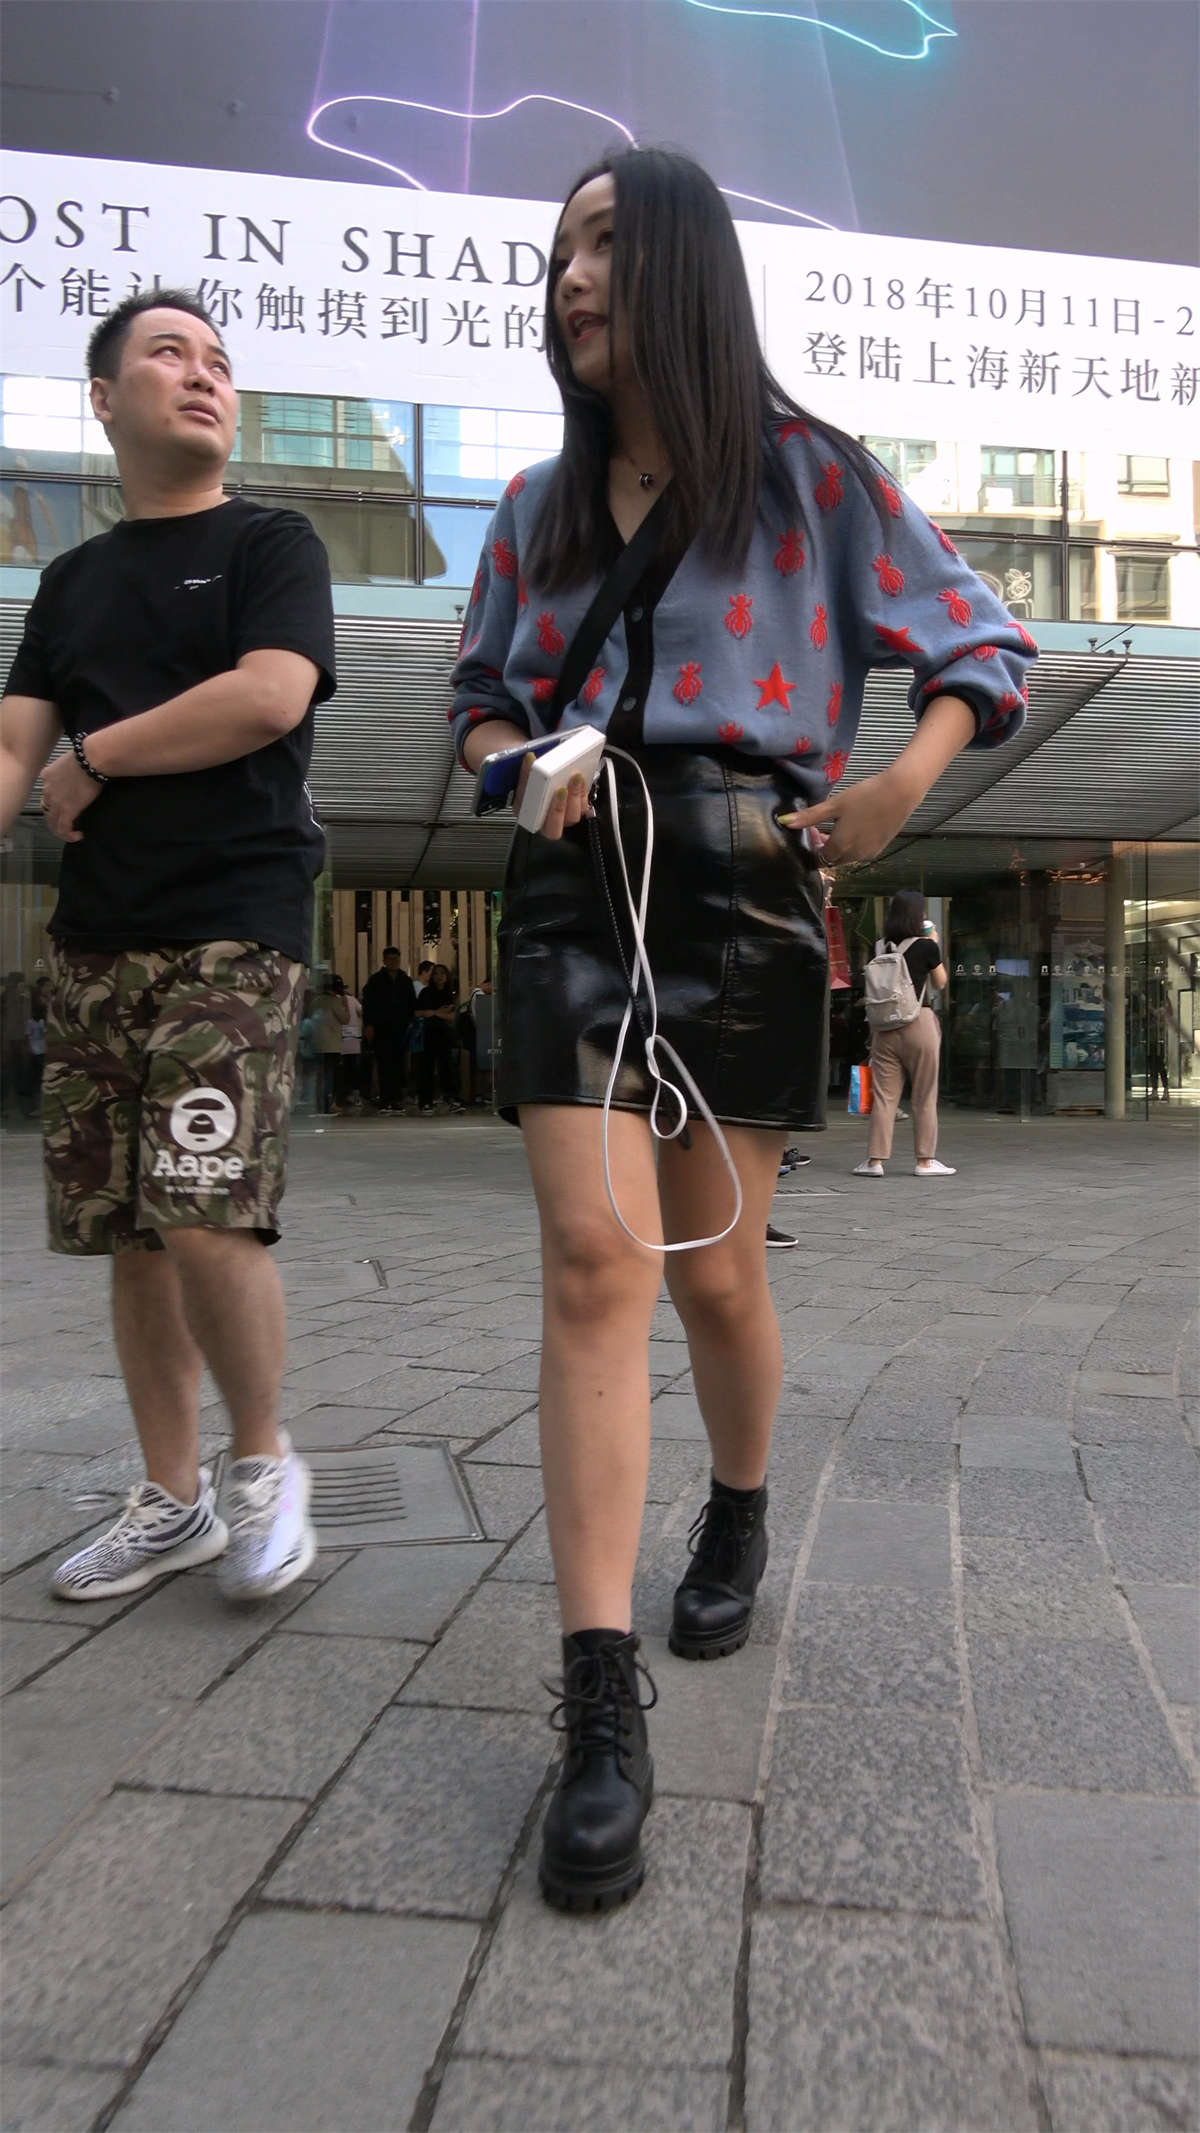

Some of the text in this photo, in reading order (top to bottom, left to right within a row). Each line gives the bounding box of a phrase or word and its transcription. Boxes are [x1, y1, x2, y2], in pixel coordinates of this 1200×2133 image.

[0, 195, 548, 287] OST IN SHAD
[152, 1149, 245, 1186] Aape
